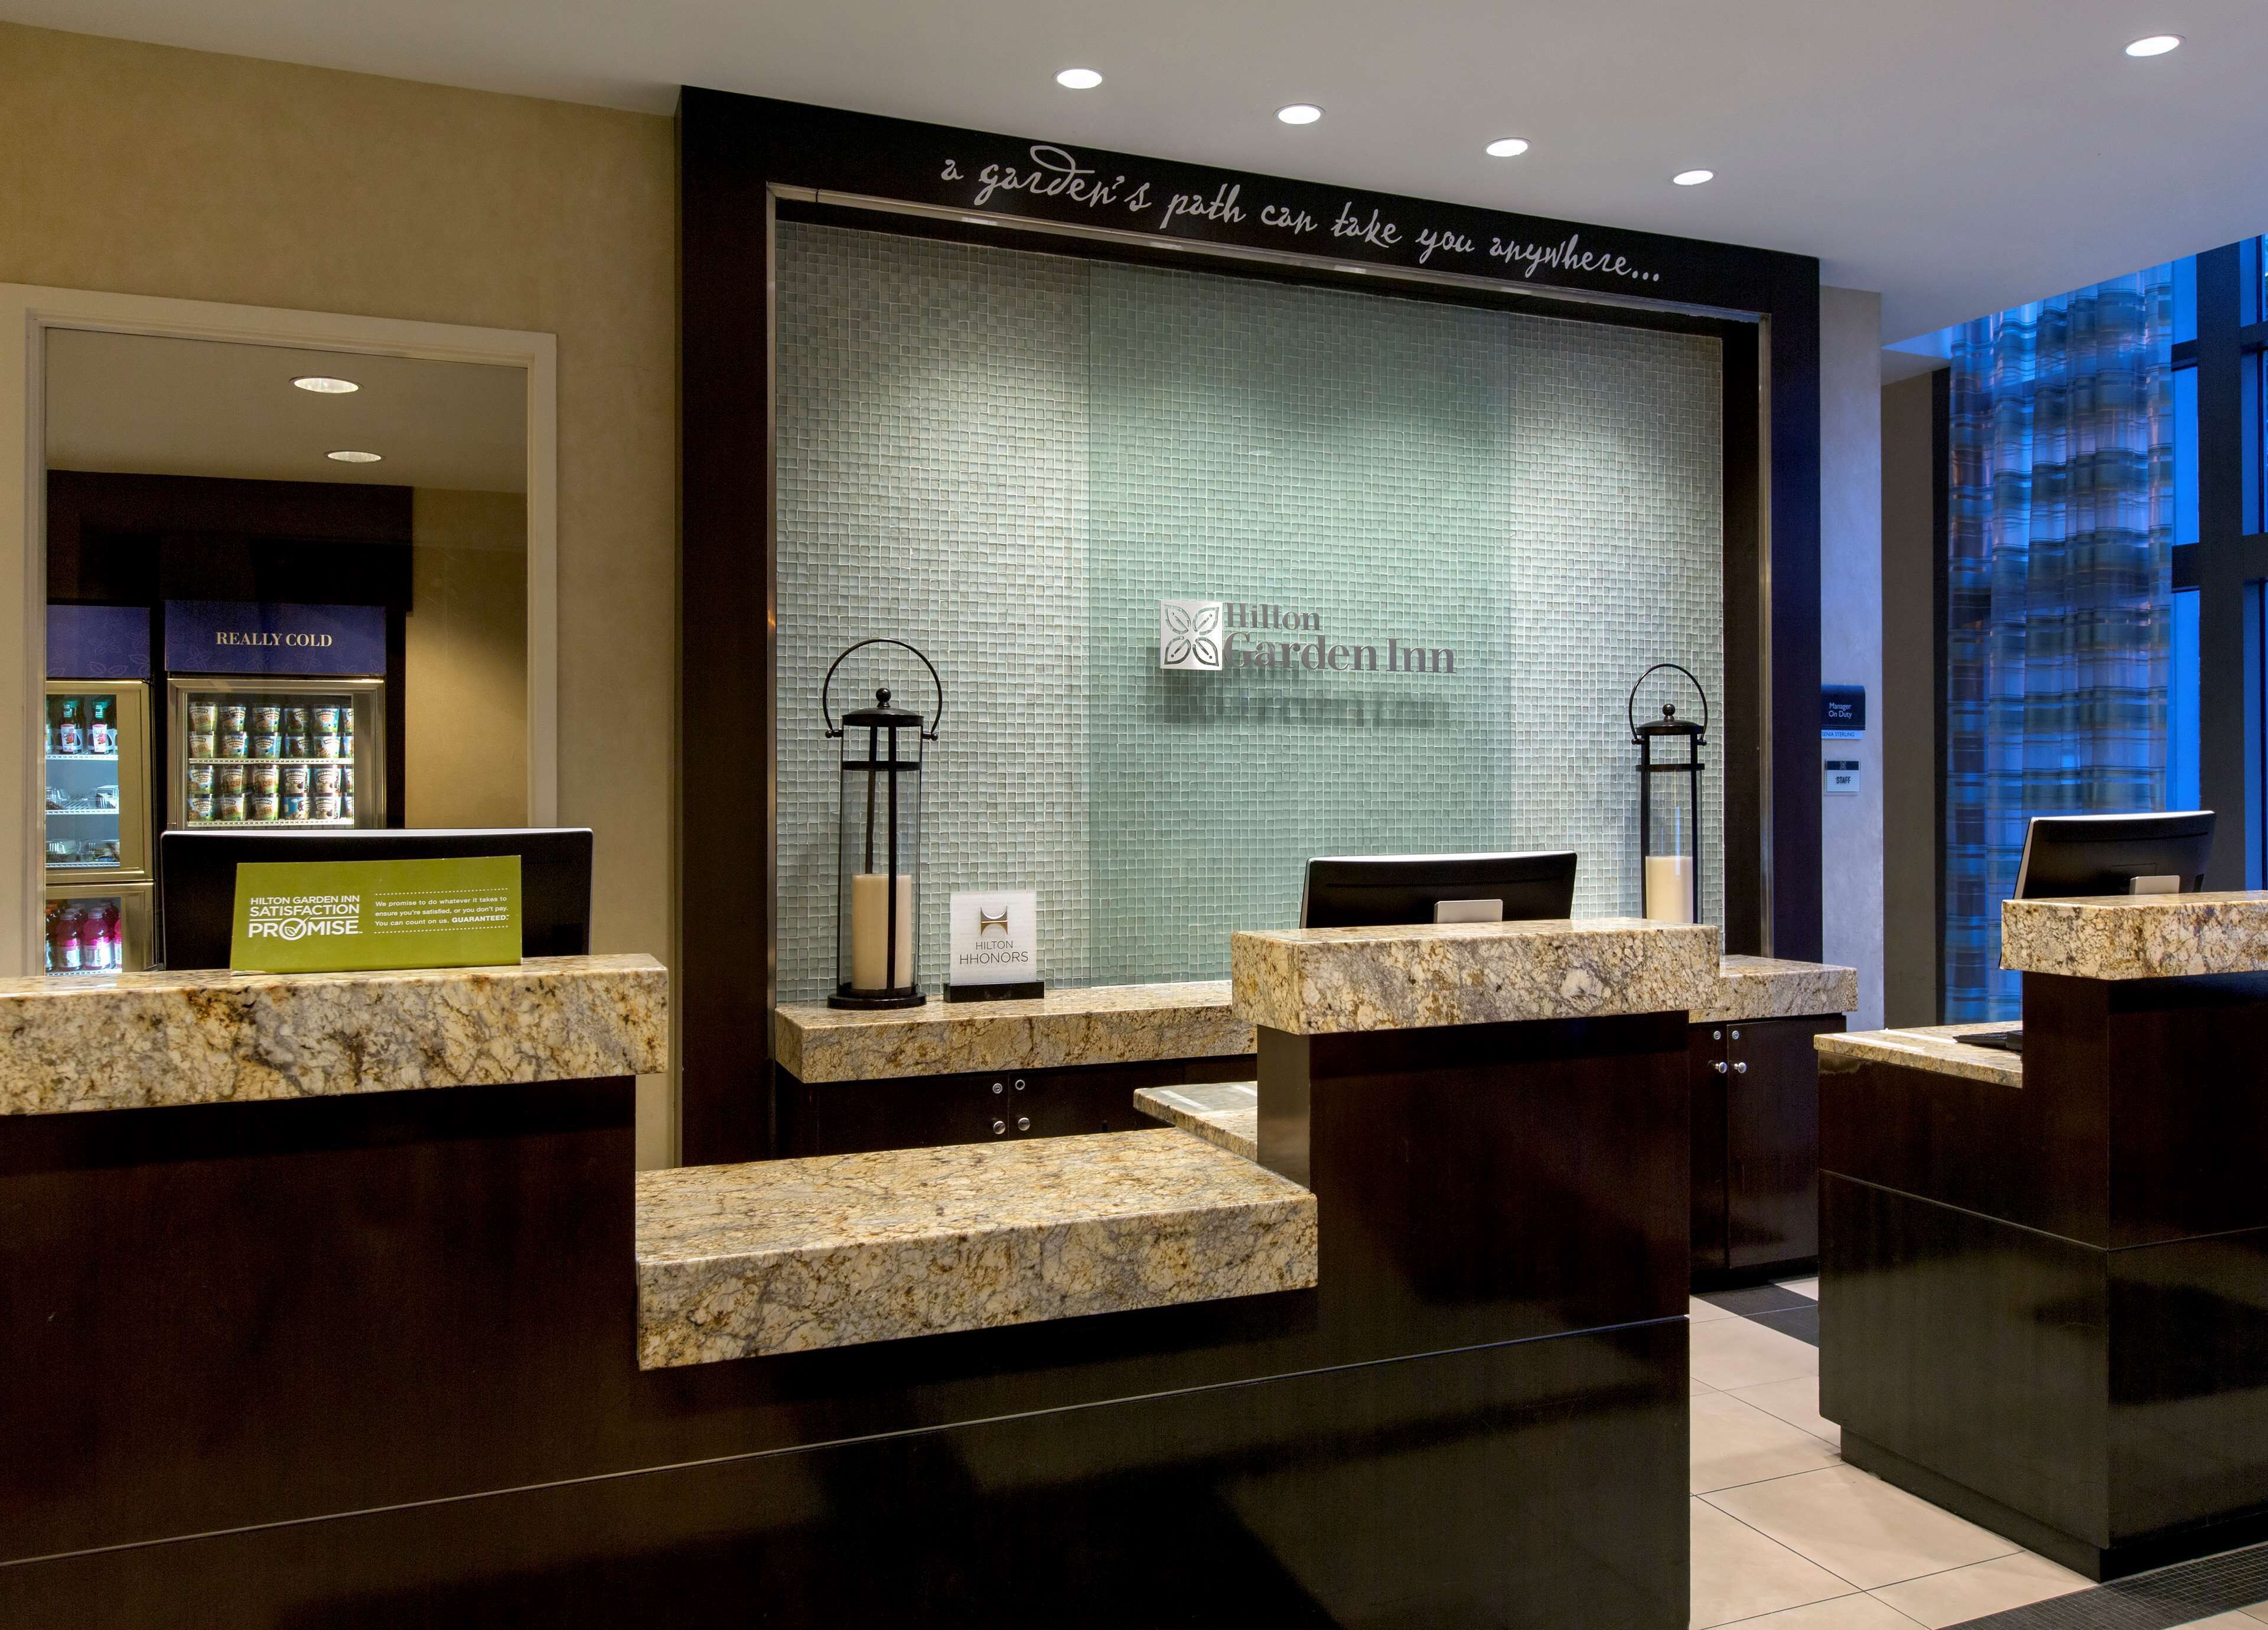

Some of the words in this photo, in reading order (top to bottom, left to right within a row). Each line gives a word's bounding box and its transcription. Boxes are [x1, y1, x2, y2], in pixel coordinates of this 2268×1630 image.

[941, 159, 964, 181] a
[973, 145, 1152, 212] garden's
[1159, 183, 1246, 229] path
[1260, 205, 1318, 235] can
[1330, 201, 1403, 248] take
[1415, 229, 1475, 264] you
[1489, 234, 1659, 282] anywhere...
[1226, 602, 1321, 631] Hilton
[216, 632, 283, 646] REALLY
[285, 633, 333, 647] COLD
[1224, 631, 1380, 671] Garden
[1386, 637, 1457, 674] Inn
[1829, 702, 1852, 711] Manager
[1839, 710, 1852, 719] Duty
[1836, 776, 1852, 785] STAFF
[250, 896, 291, 905] HILTON
[292, 895, 339, 904] GARDEN
[341, 894, 360, 903] INN
[249, 903, 360, 917] SATISFACTION
[495, 905, 509, 913] pay.
[975, 940, 1014, 951] HILTON
[959, 951, 1029, 965] HHONORS
